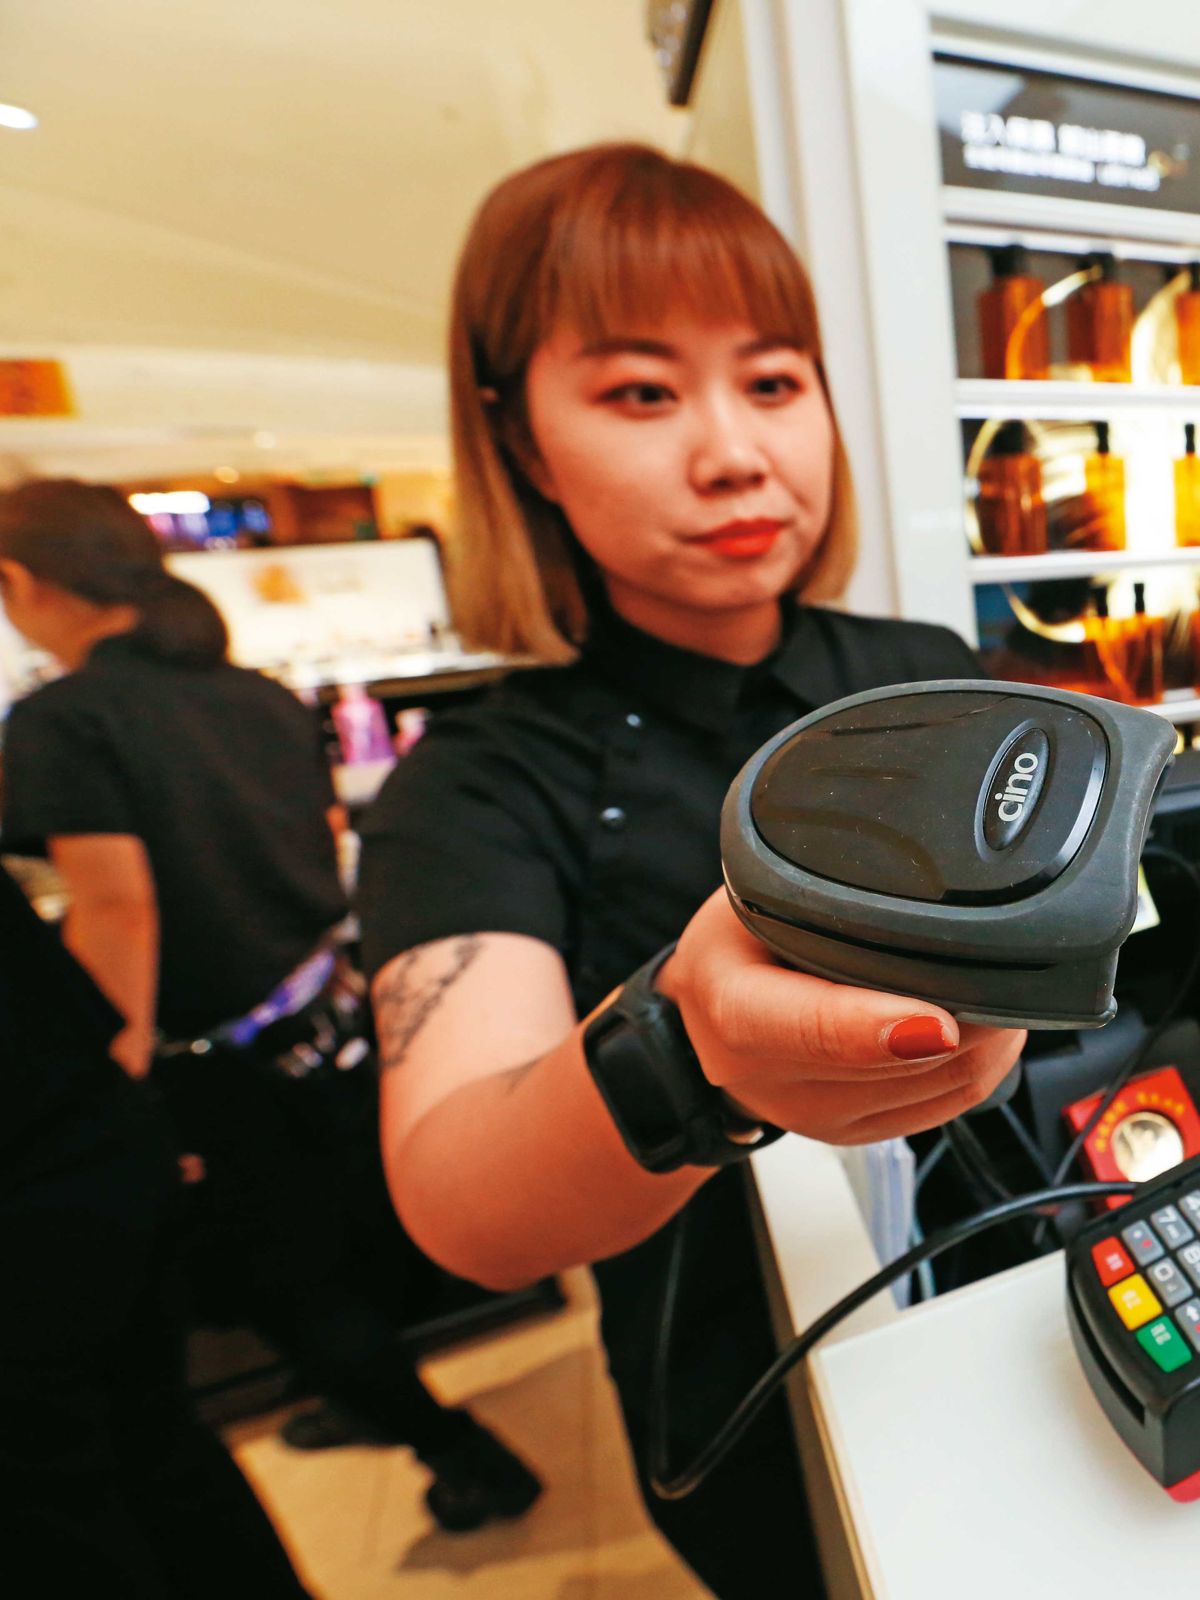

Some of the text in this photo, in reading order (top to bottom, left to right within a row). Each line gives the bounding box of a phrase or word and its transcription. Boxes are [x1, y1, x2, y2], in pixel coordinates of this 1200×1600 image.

[995, 752, 1038, 822] cino
[1158, 1209, 1177, 1225] 7
[1154, 1264, 1173, 1281] 0
